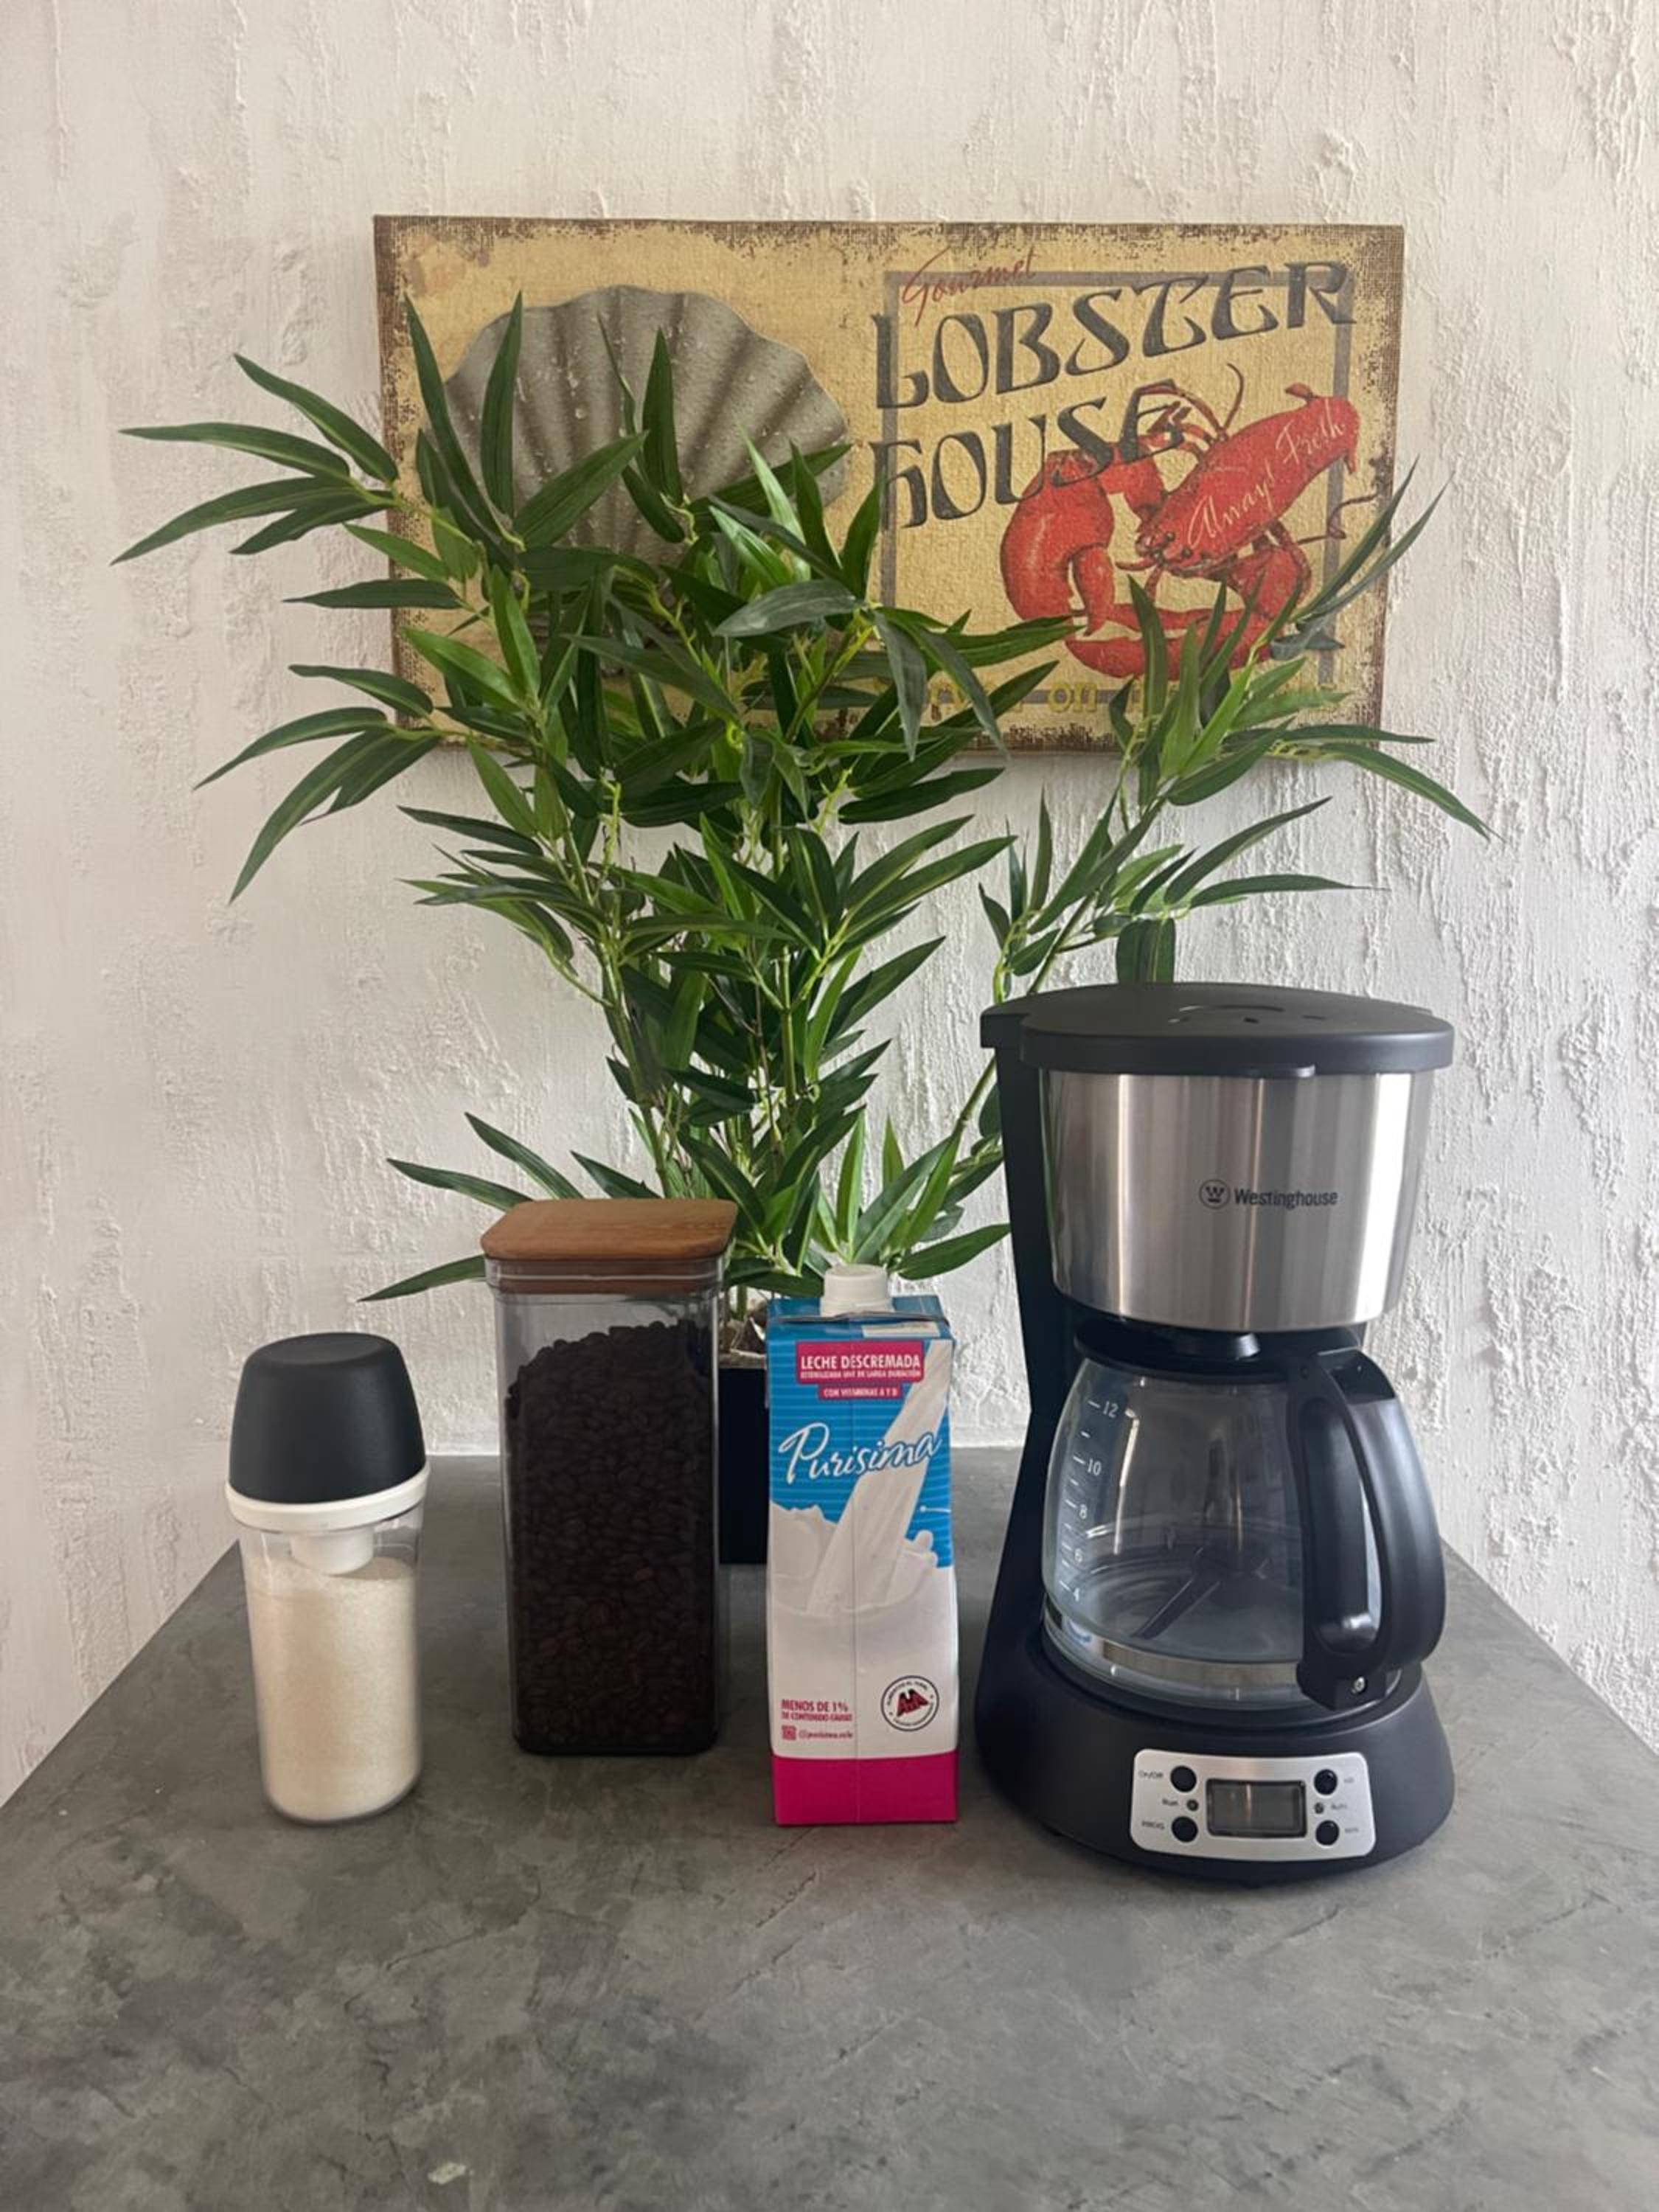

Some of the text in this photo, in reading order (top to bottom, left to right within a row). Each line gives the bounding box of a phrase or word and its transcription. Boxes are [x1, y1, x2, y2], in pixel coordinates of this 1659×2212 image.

[870, 261, 1357, 410] LOBSTER
[1234, 1188, 1338, 1211] Westinghouse
[801, 1354, 921, 1370] LECHE DESCREMADA
[1103, 1402, 1119, 1419] 12
[1087, 1458, 1102, 1475] 10
[1078, 1504, 1088, 1520] 8
[782, 1699, 849, 1712] MENOS DE 1%
